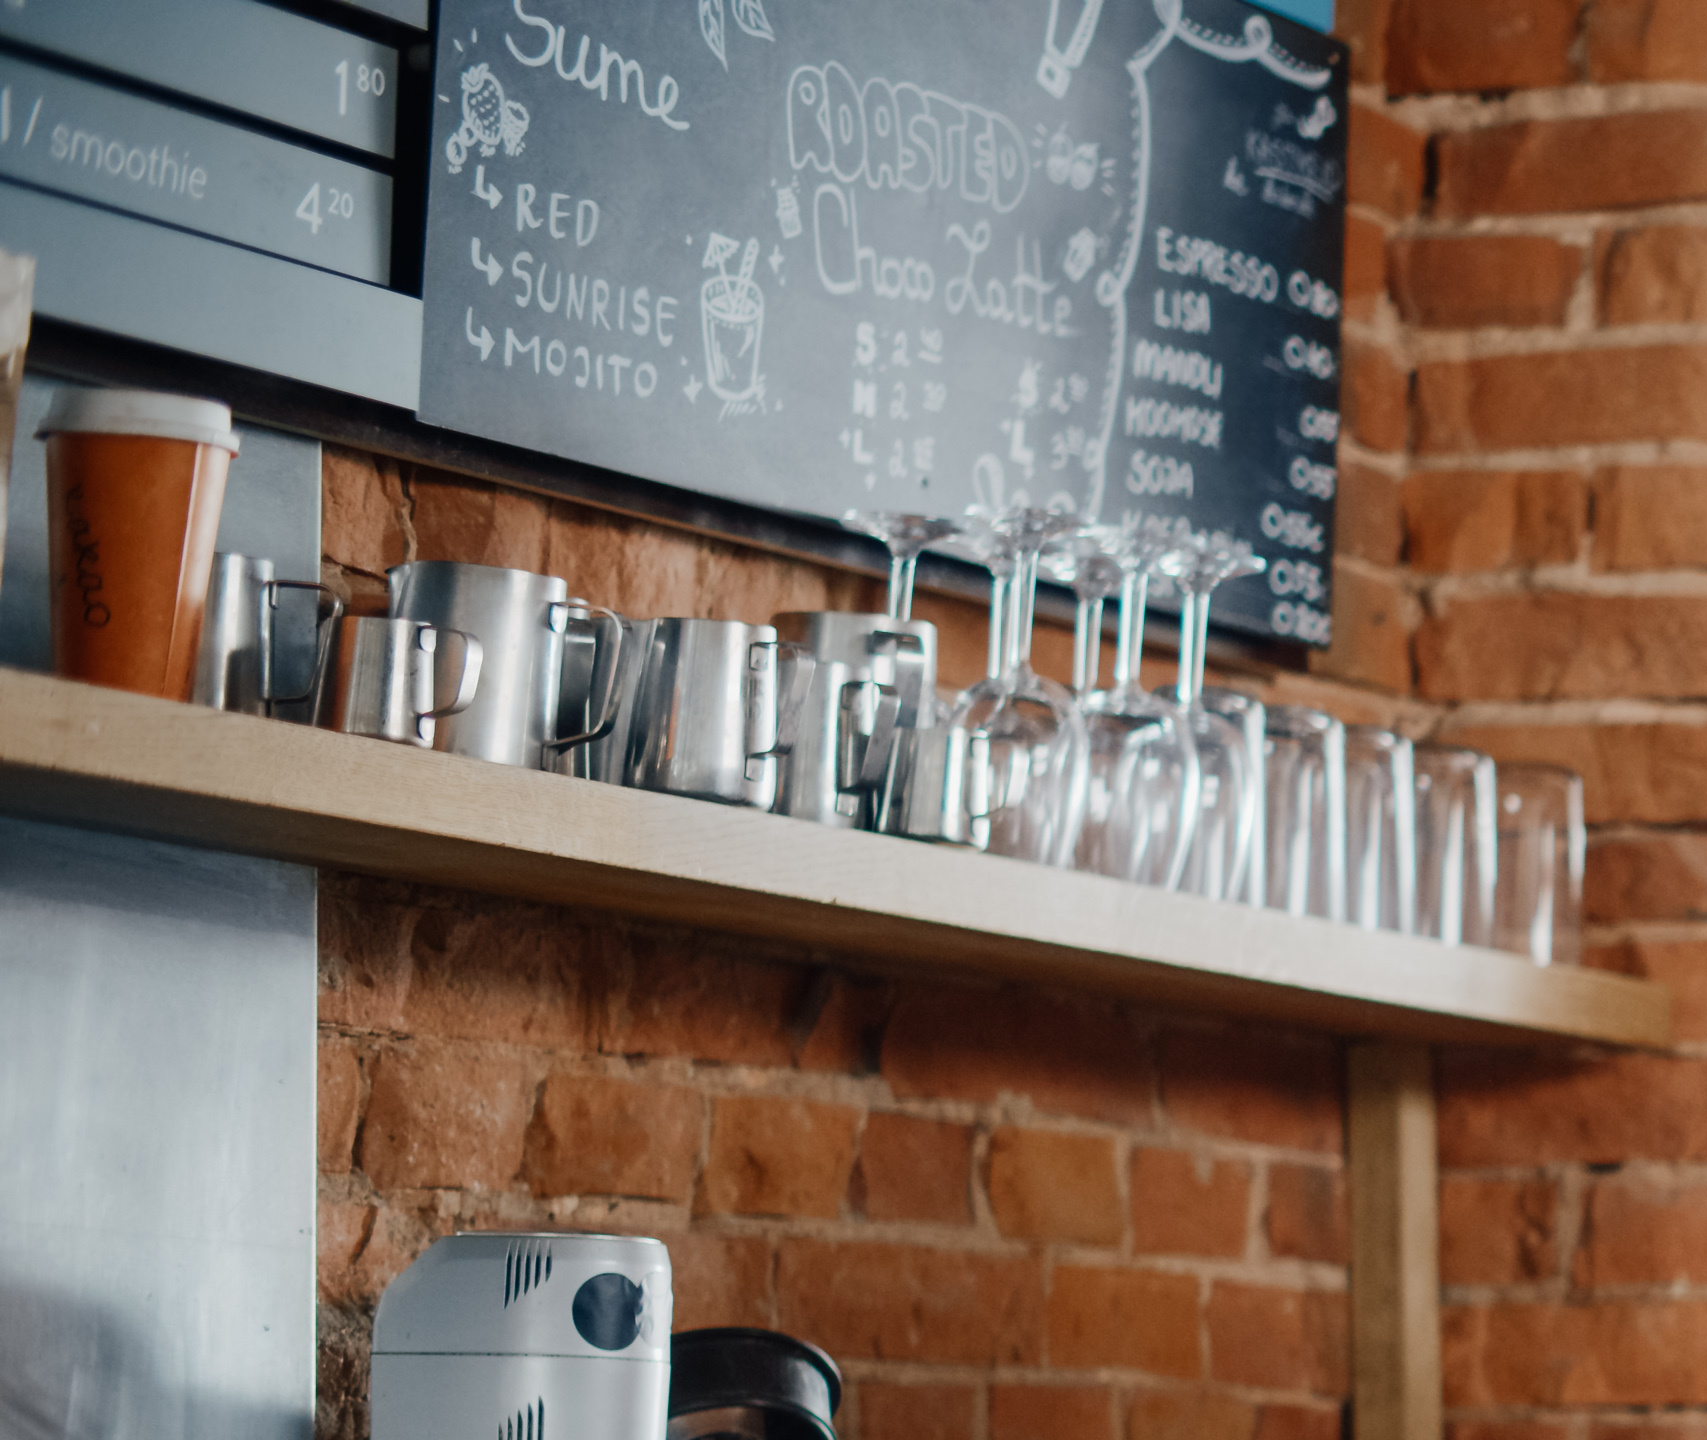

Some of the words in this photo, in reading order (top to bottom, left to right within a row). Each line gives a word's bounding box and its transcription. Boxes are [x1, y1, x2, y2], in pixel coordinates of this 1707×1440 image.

[52, 122, 207, 198] smoothie
[788, 59, 1030, 213] ROASTED
[515, 183, 599, 246] RED
[814, 182, 936, 302] Choco
[511, 250, 678, 347] SUNRISE
[1157, 226, 1279, 303] ESPRESSO
[1154, 287, 1210, 335] LISA
[503, 327, 658, 398] MOJITO
